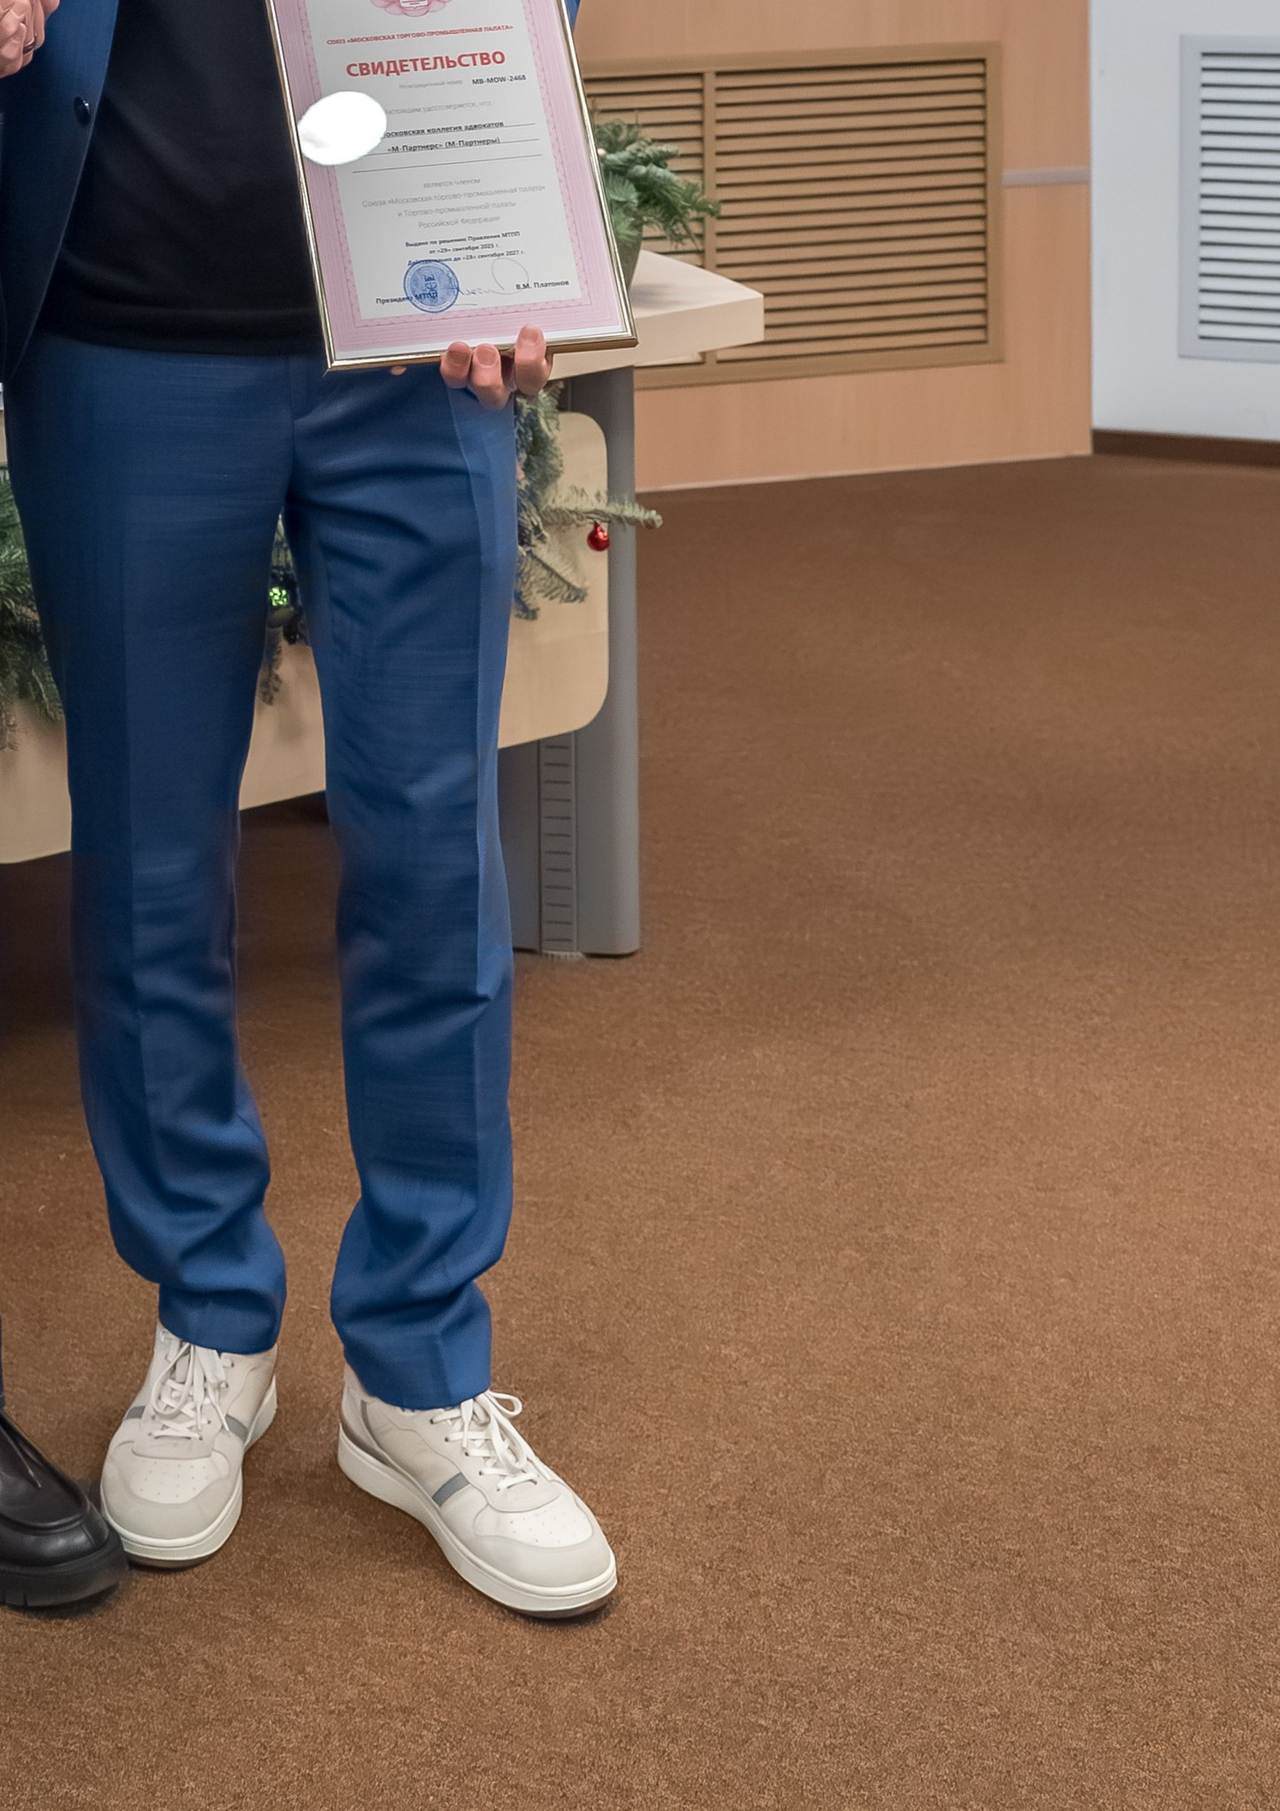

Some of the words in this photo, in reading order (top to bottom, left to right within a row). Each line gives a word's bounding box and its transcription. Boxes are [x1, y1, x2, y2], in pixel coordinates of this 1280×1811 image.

[346, 50, 506, 77] СВИДЕТЕЛЬСТВО
[383, 129, 425, 138] осковская
[426, 125, 462, 135] коллегия
[464, 121, 504, 132] адвокатов
